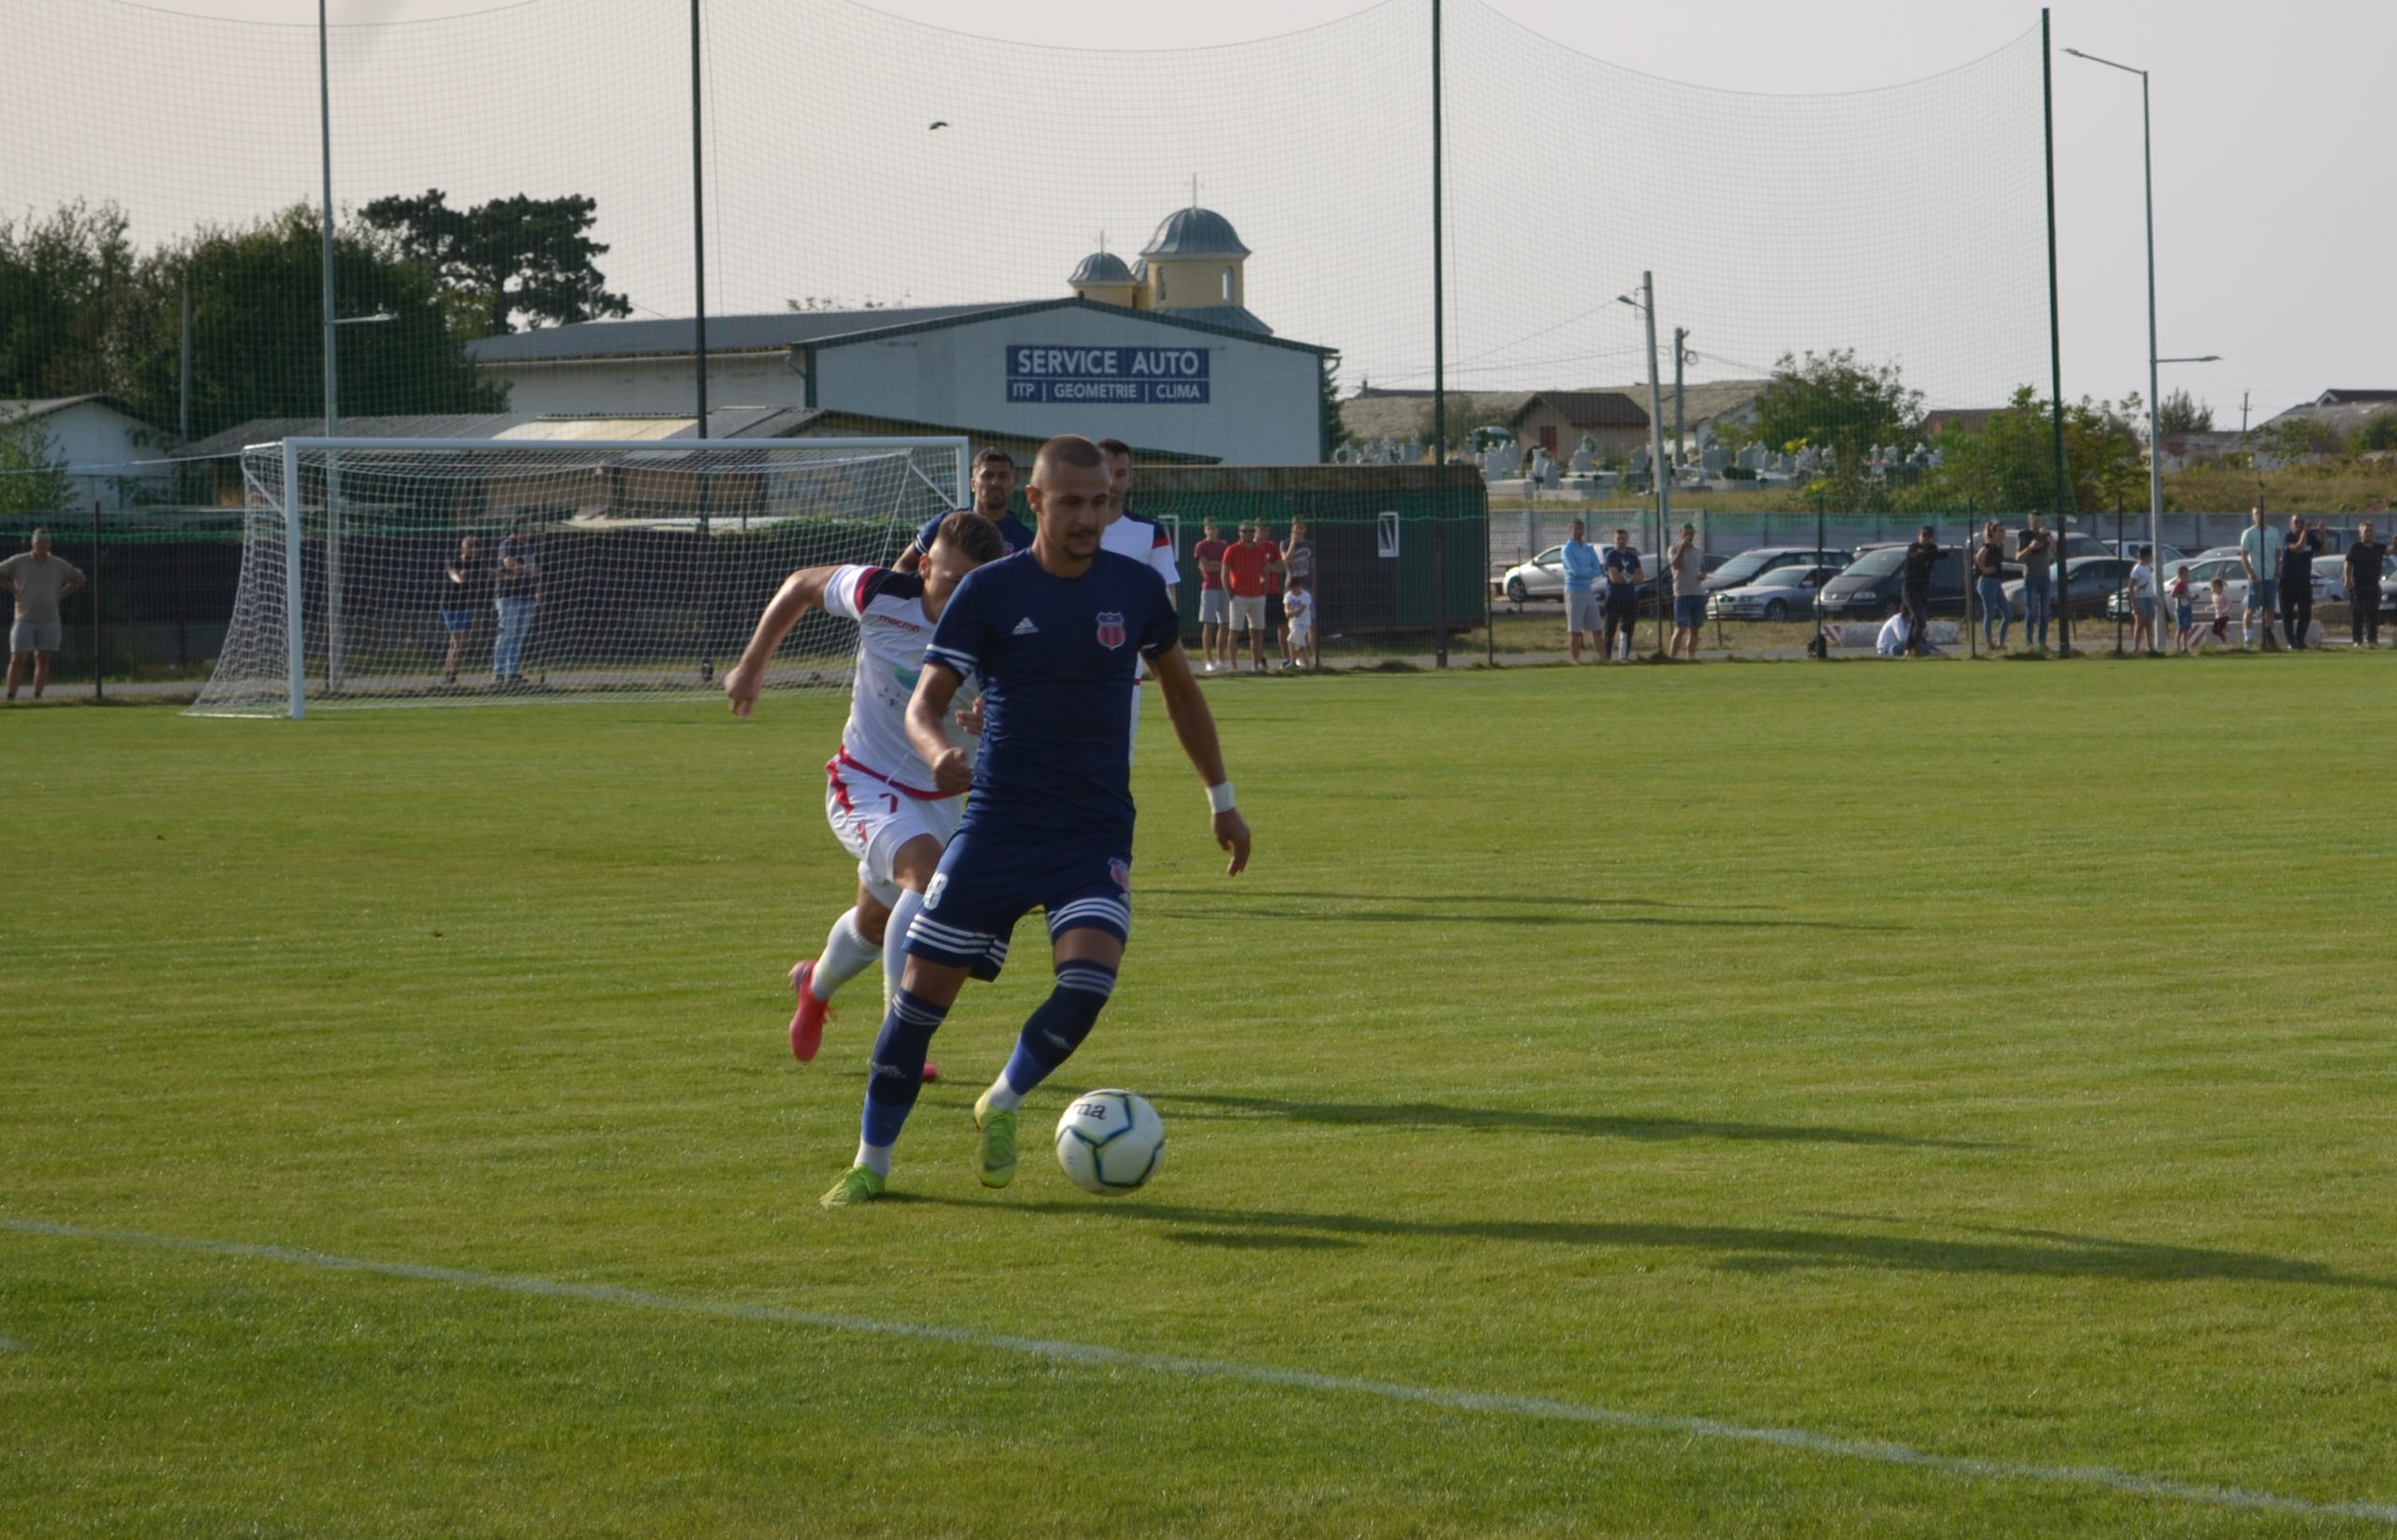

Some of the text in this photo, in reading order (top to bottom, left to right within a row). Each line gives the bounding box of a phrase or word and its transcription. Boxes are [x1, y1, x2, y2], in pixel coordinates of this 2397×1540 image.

[1018, 349, 1199, 374] SERVICE AUTO
[1012, 383, 1200, 399] ITP GEOMETRIE CLIMA
[878, 792, 898, 814] 7
